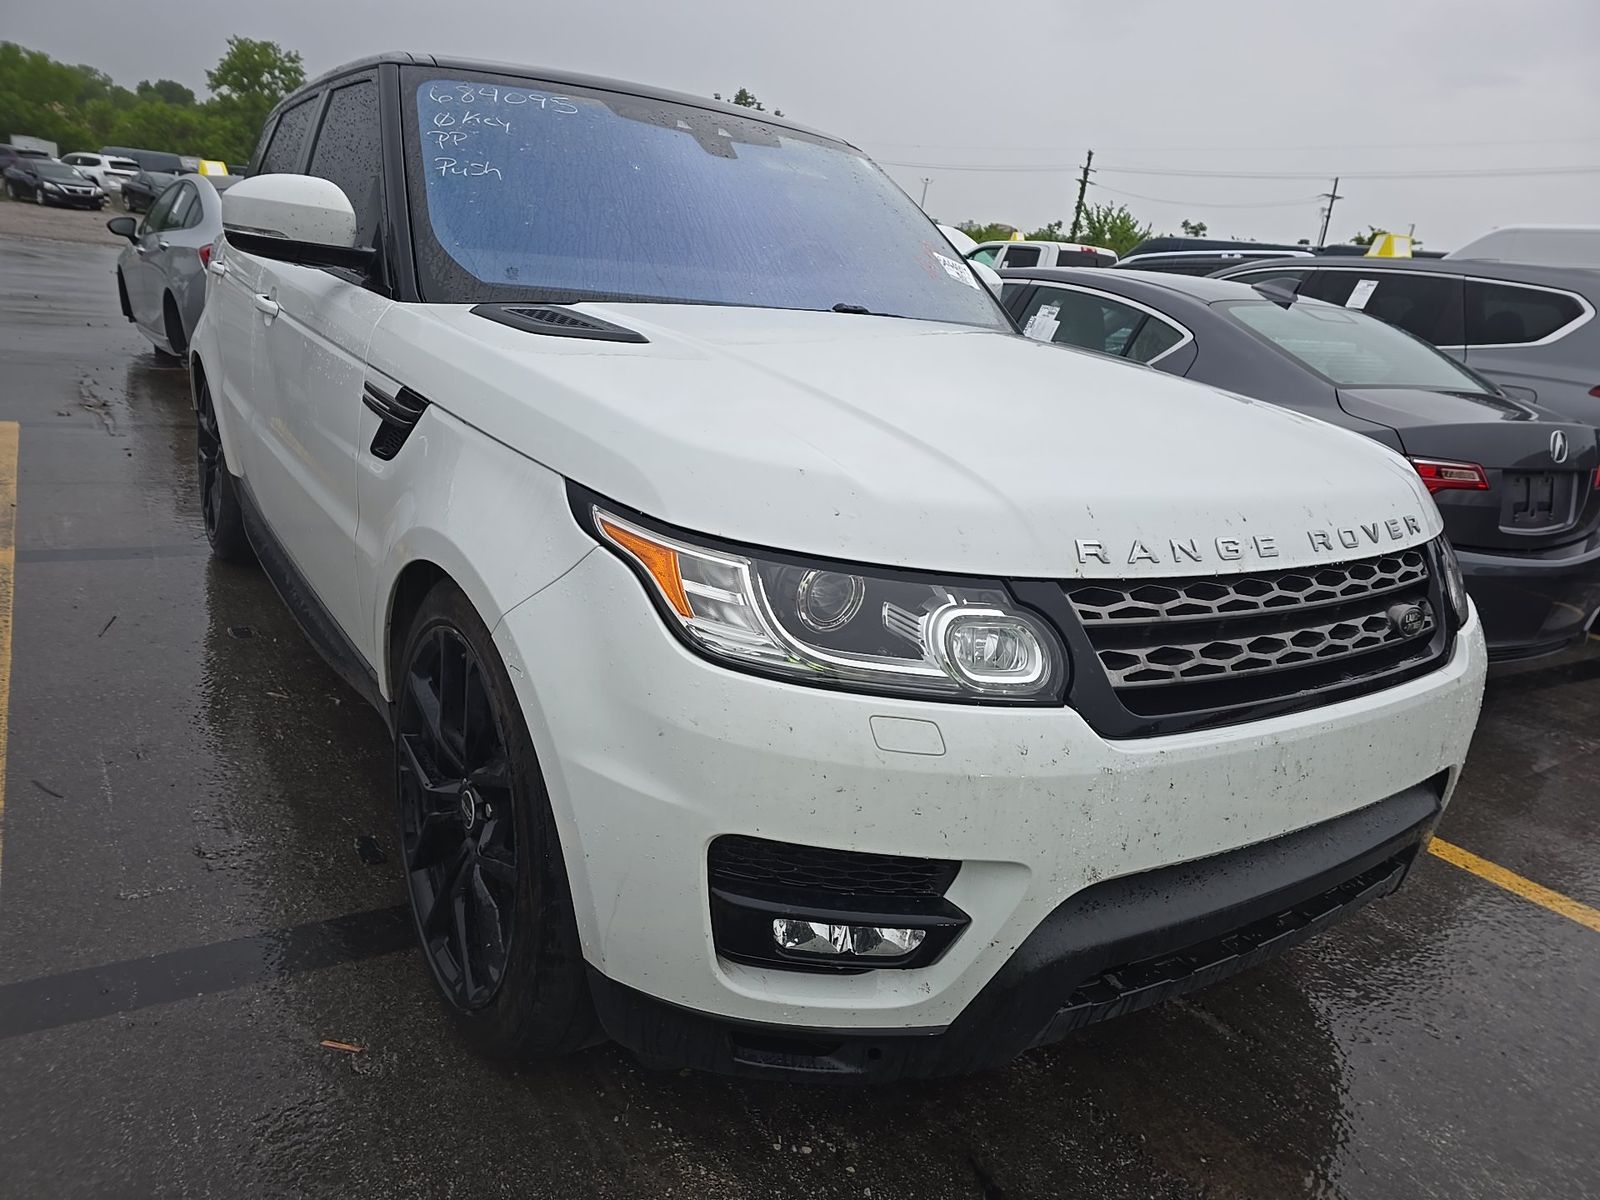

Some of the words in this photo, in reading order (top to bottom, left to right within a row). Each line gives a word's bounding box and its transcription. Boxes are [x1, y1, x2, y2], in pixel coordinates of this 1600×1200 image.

[430, 86, 578, 114] 684095
[1074, 535, 1279, 564] RANGE
[1306, 514, 1422, 553] ROVER
